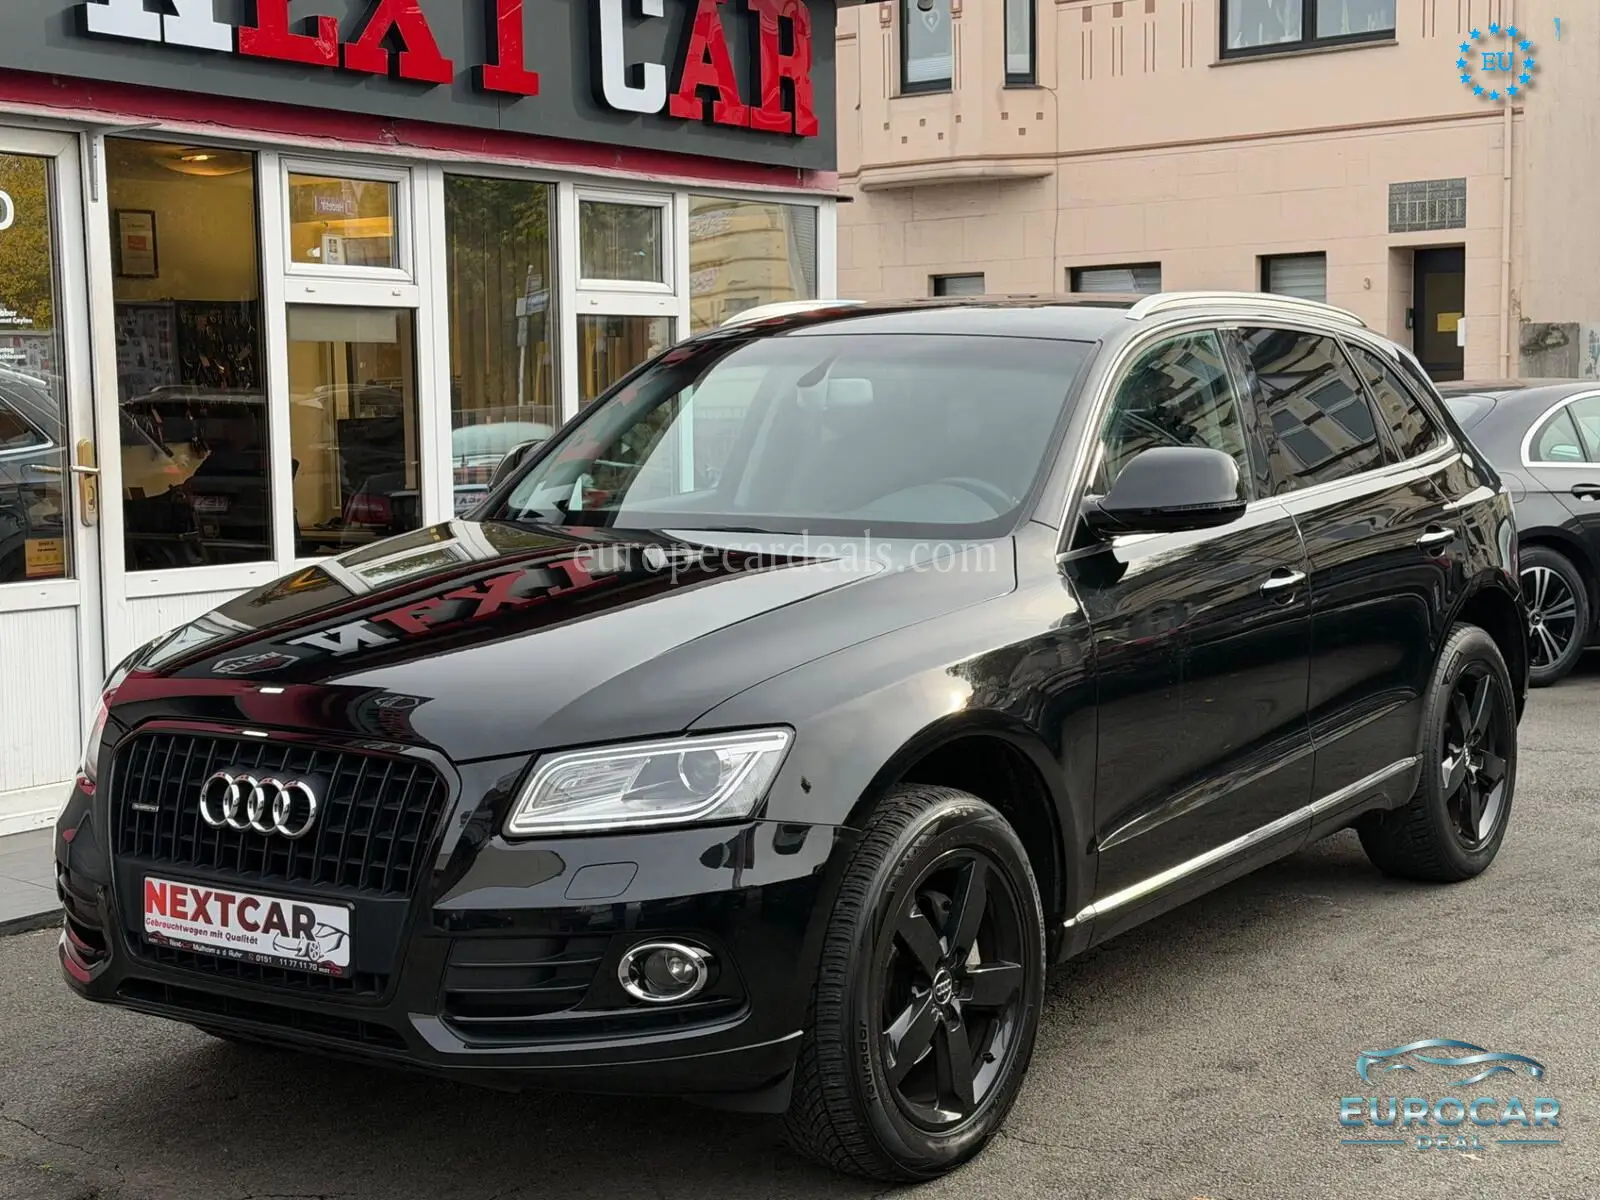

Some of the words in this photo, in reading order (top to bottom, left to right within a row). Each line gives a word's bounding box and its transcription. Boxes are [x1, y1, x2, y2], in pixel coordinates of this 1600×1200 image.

[600, 0, 818, 136] CAR
[1363, 277, 1372, 290] 3
[145, 879, 316, 942] NEXTCAR
[145, 917, 208, 938] Gebrauchtwagen
[209, 929, 224, 940] mit
[224, 932, 258, 945] Qualität
